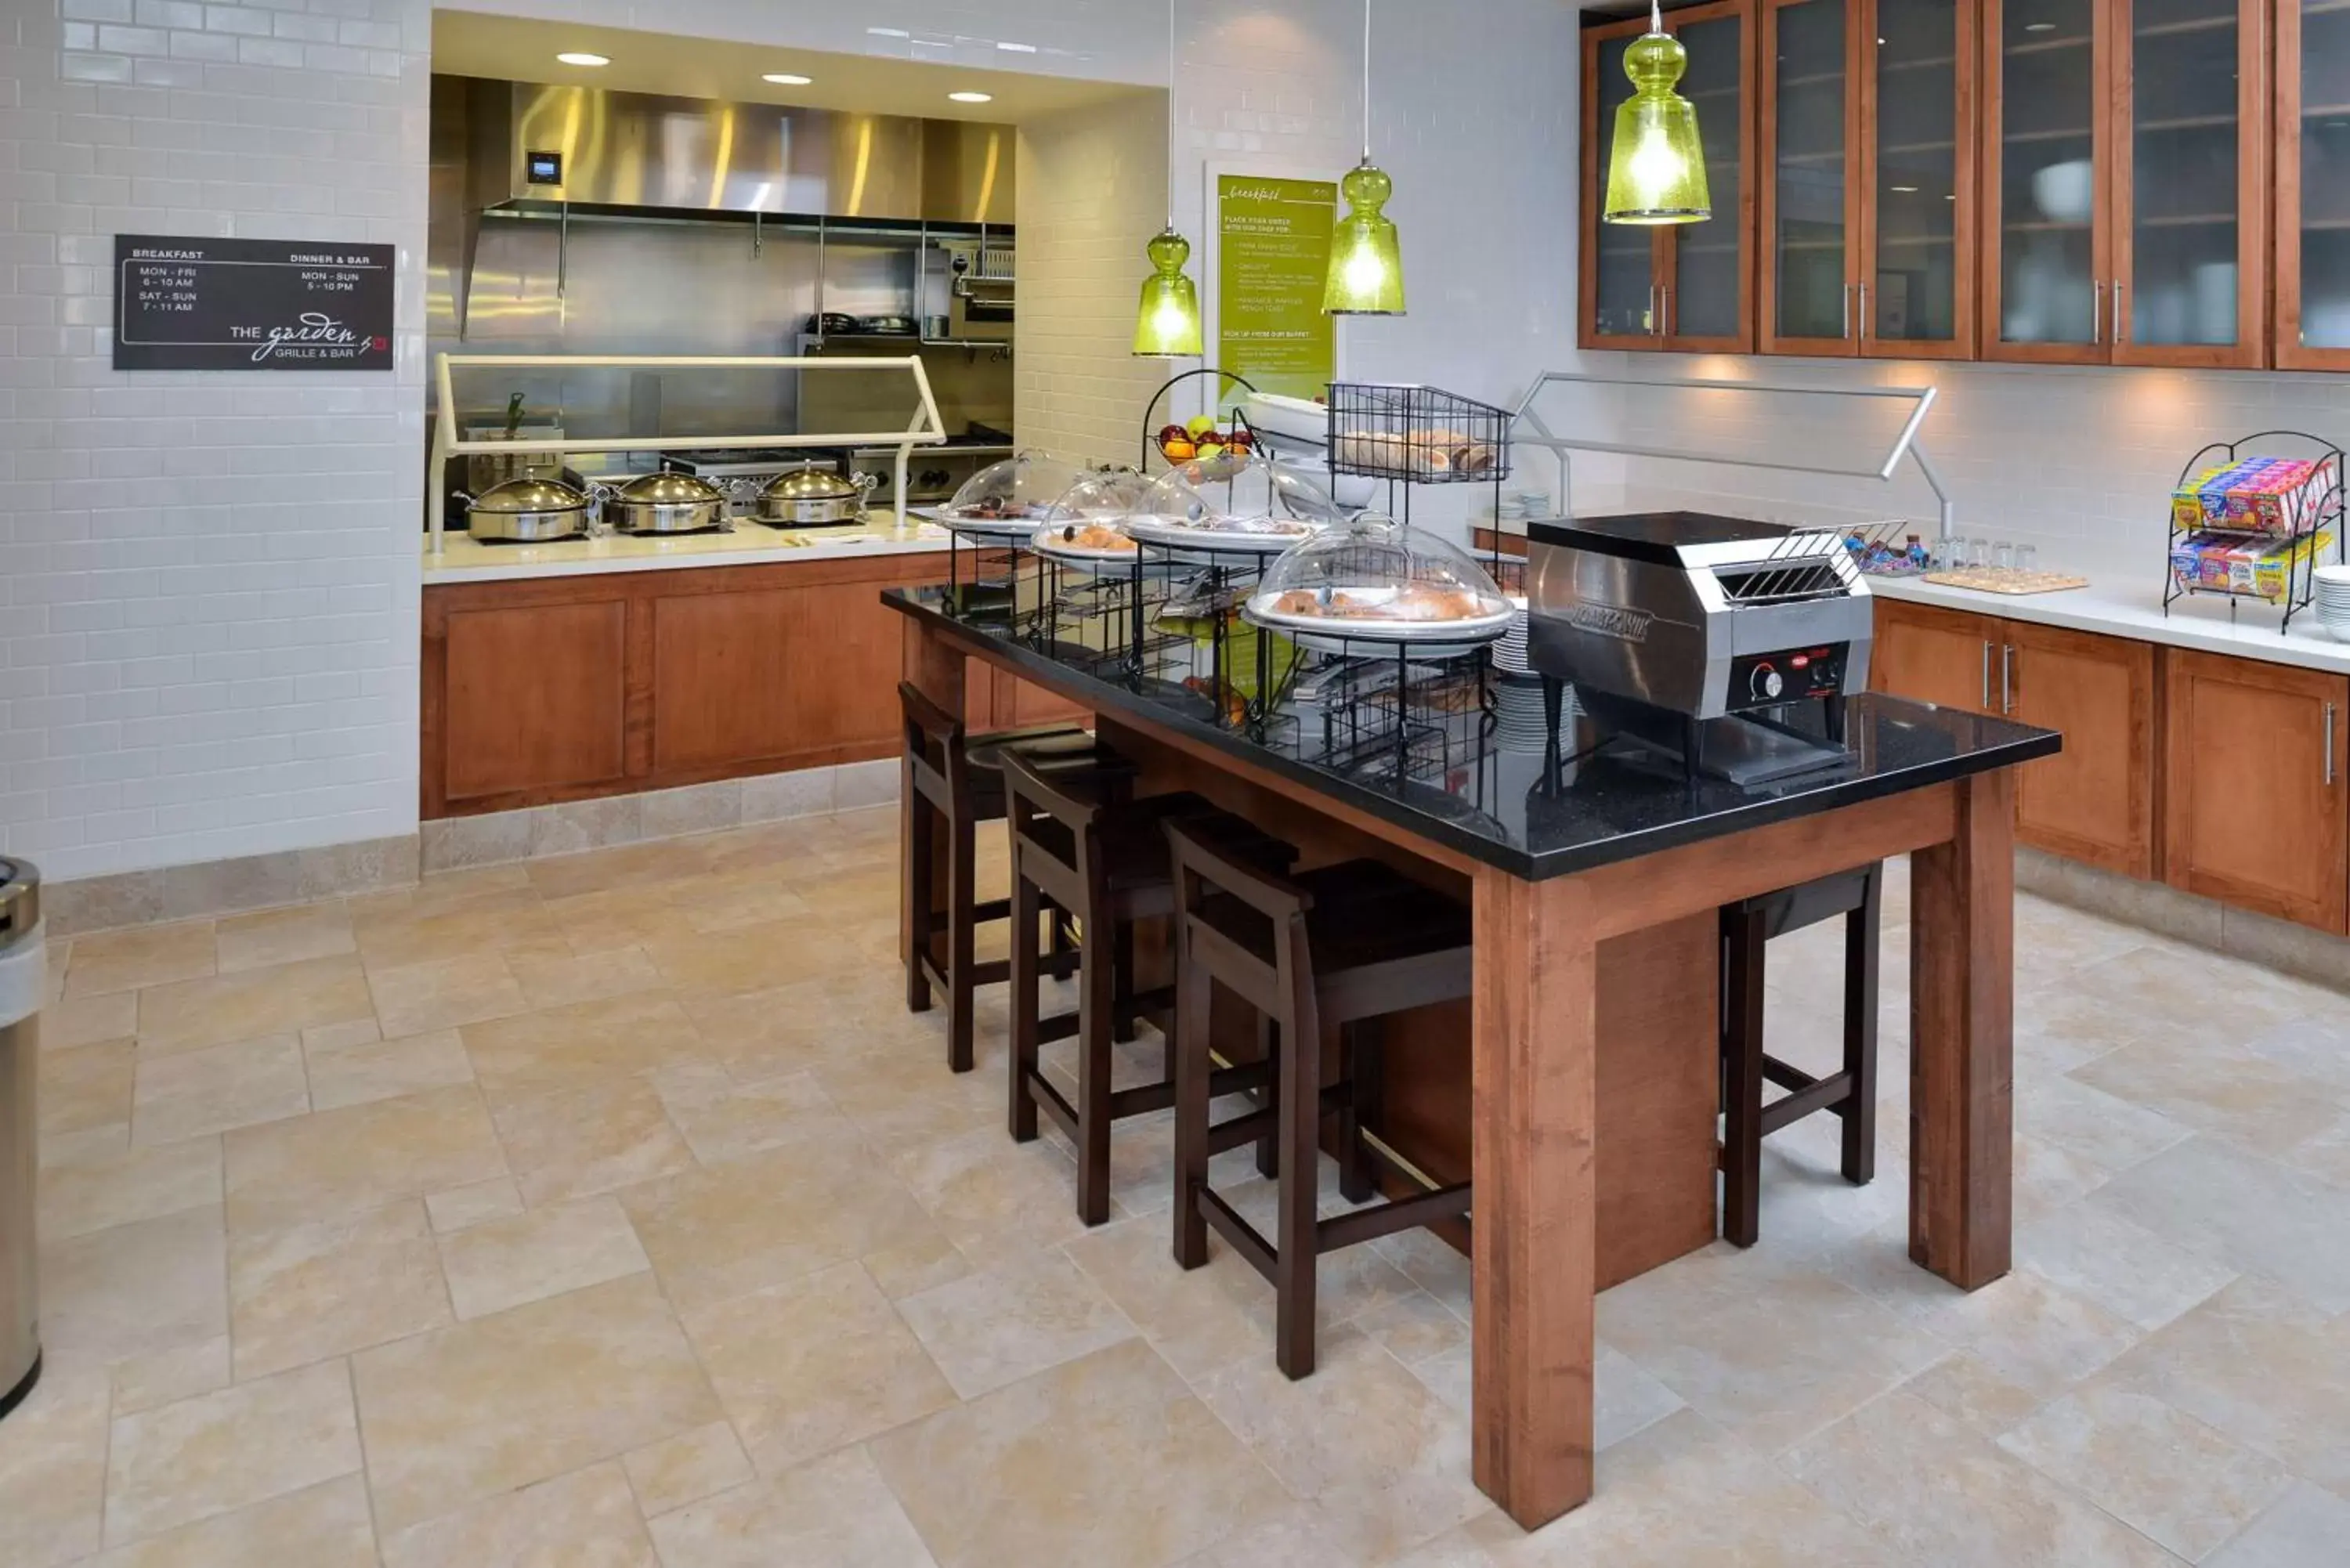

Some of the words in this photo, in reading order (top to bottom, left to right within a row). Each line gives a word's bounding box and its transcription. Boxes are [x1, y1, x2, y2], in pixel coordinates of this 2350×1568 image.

[132, 248, 204, 259] BREAKFAST
[290, 254, 333, 264] DINNER
[139, 267, 167, 276] MON
[178, 268, 197, 276] FRI
[301, 272, 327, 280] MON
[336, 273, 360, 281] SUN
[161, 278, 173, 287] 10
[175, 278, 193, 287] AM
[337, 283, 353, 291] PM
[139, 291, 161, 300] SAT
[172, 292, 197, 301] SUN
[143, 302, 150, 311] 7
[230, 326, 261, 338] THE
[251, 313, 356, 361] garden
[275, 349, 316, 358] GRILLE
[319, 349, 327, 358] &
[330, 349, 353, 358] BAR
